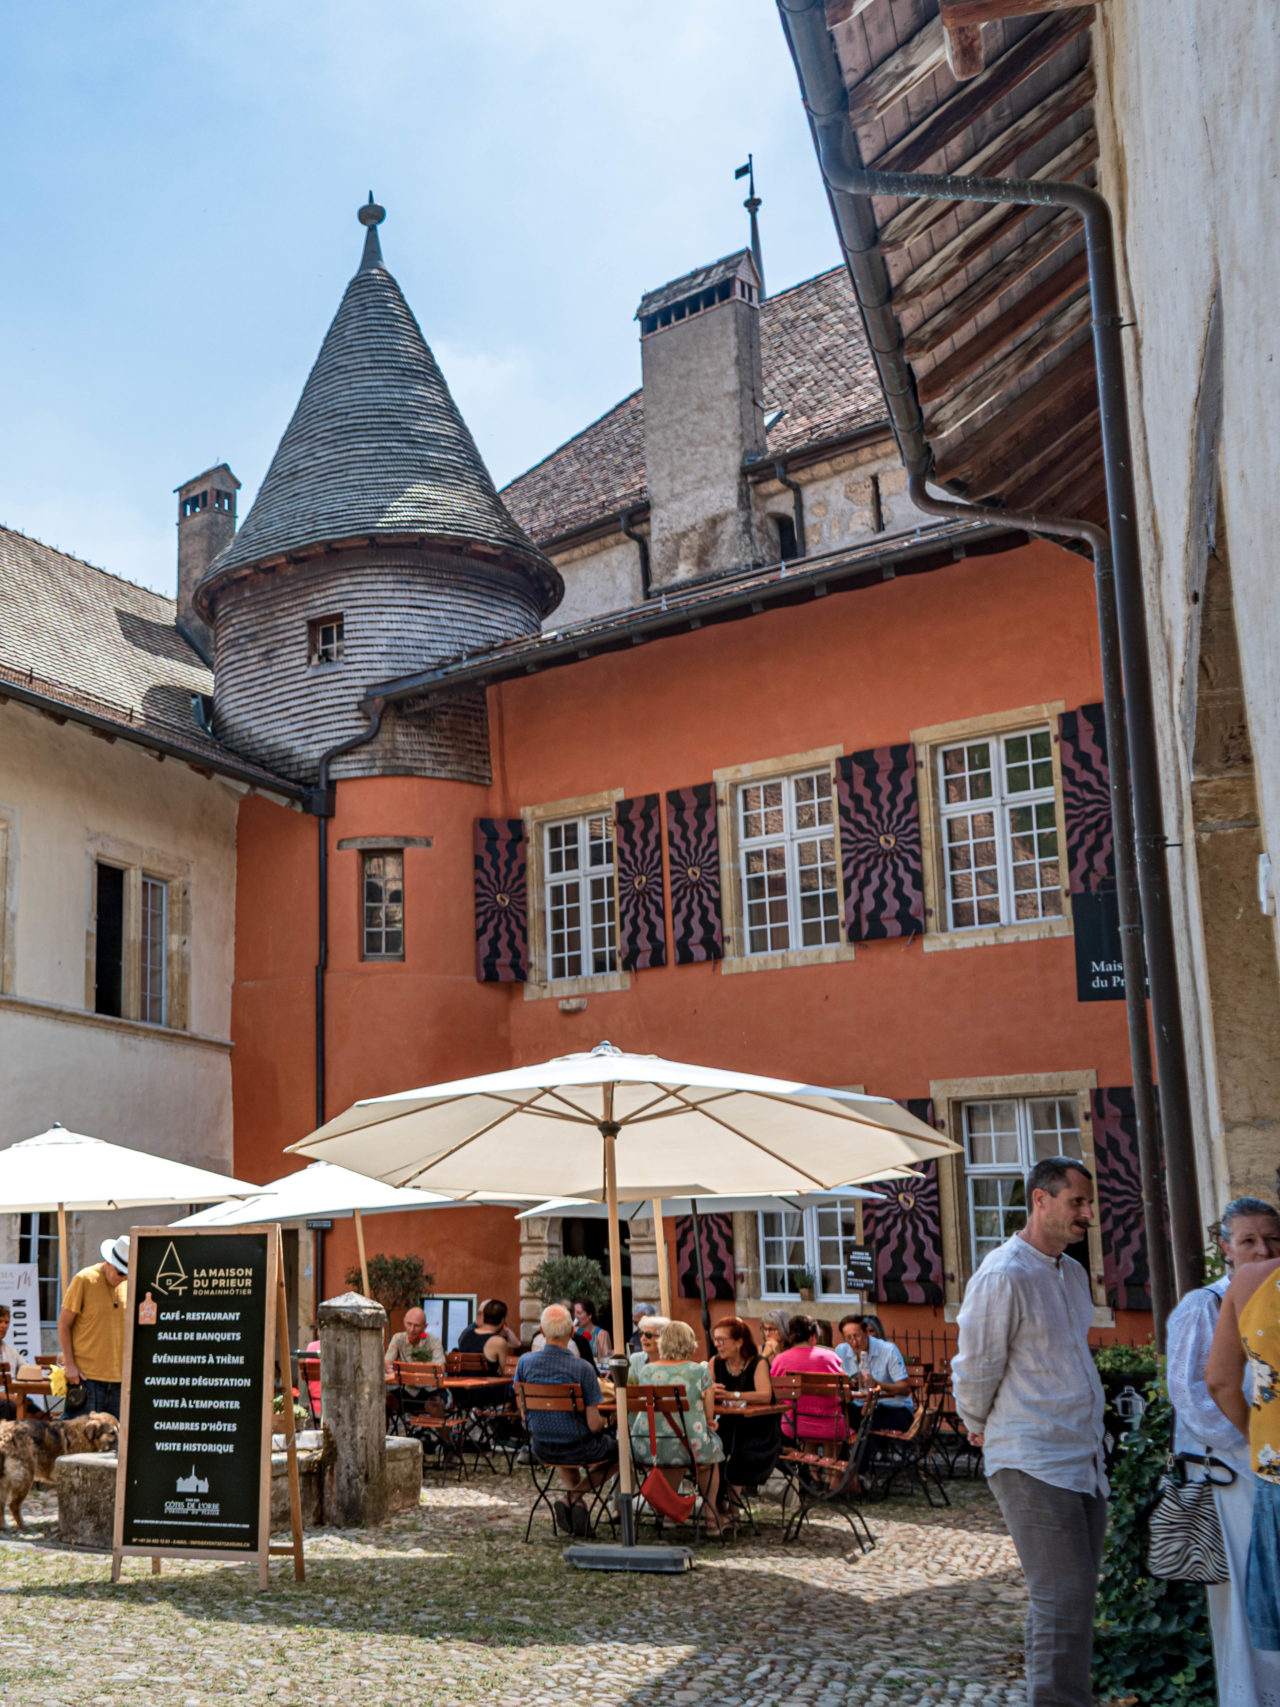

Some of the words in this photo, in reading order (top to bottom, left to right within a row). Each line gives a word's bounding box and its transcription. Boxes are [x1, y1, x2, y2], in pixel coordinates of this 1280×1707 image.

[1091, 960, 1123, 972] Mais
[1092, 975, 1108, 988] du
[193, 1268, 207, 1277] LA
[209, 1268, 253, 1277] MAISON
[193, 1279, 209, 1288] DU
[212, 1278, 252, 1287] PRIEUR
[193, 1288, 252, 1296] ROMAINMÔTIER
[160, 1310, 181, 1320] CAFÉ
[186, 1312, 240, 1320] RESTAURANT
[12, 1299, 29, 1357] SITION
[157, 1332, 182, 1340] SALLE
[184, 1332, 195, 1340] DE
[196, 1332, 241, 1342] BANQUETS
[152, 1353, 207, 1364] ÉVÉNEMENTS
[207, 1353, 215, 1364] À
[216, 1353, 245, 1364] THÈME
[144, 1377, 178, 1385] CAVEAU
[179, 1377, 190, 1385] DE
[191, 1376, 251, 1387] DÉGUSTATION
[153, 1399, 179, 1408] VENTE
[180, 1397, 187, 1408] À
[188, 1399, 240, 1409] L'EMPORTER
[154, 1421, 200, 1431] CHAMBRES
[201, 1420, 237, 1432] D'HÔTES
[155, 1442, 181, 1451] VISITE
[183, 1442, 234, 1454] HISTORIQUE
